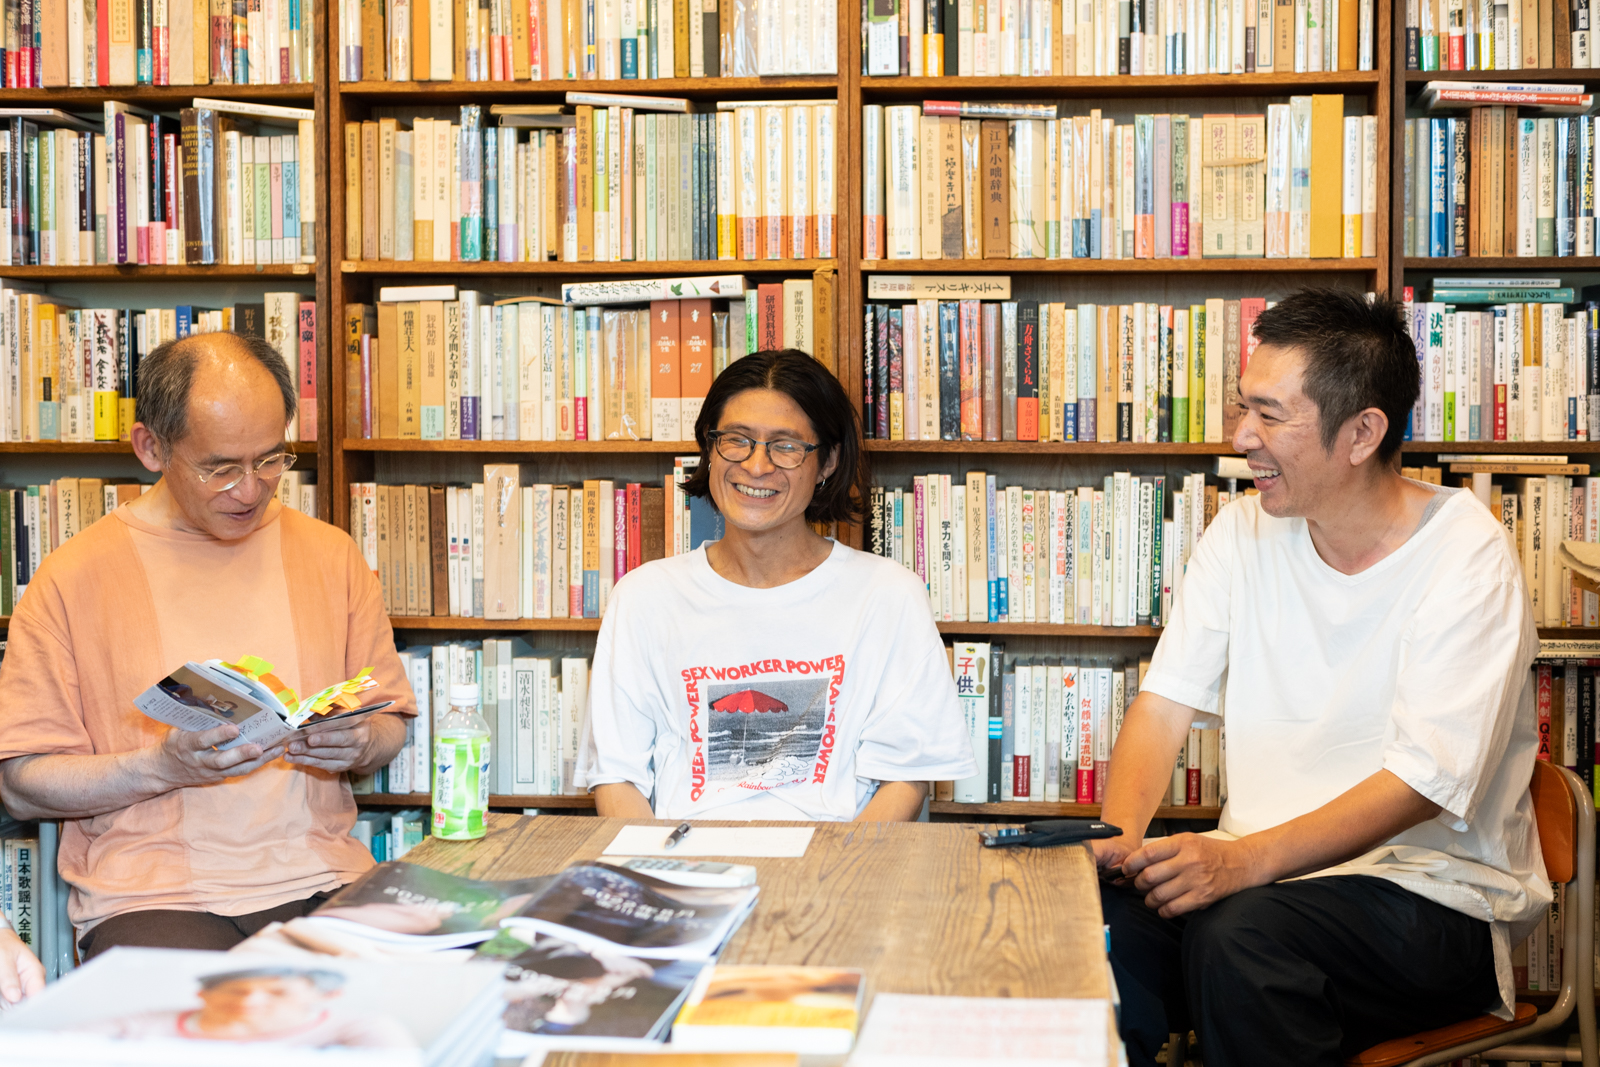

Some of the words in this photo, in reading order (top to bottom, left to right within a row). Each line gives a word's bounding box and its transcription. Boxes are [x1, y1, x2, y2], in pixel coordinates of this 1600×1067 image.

[989, 130, 1003, 203] 江戸小咄辞典
[1454, 120, 1466, 206] 殺される側の論理
[924, 281, 1005, 293] イエス・キリスト
[449, 306, 459, 389] 江戸文学問わず語り
[794, 290, 804, 351] 評論明治大正の歌
[1005, 308, 1016, 377] 安部公房全作品
[1123, 314, 1133, 356] わが大正
[1228, 305, 1237, 341] 安部公房
[1430, 312, 1444, 348] 決断
[1554, 307, 1563, 353] 国民の天皇
[1023, 323, 1034, 386] 方舟さくら丸
[1122, 362, 1133, 393] 秋山清
[1511, 309, 1520, 401] デモクラシーの理想と現実
[450, 400, 458, 432] 円地文子
[1003, 388, 1017, 397] 14
[1025, 401, 1034, 434] 安部公房
[1041, 377, 1049, 416] 安岡章太郎
[535, 489, 548, 575] マガジン青春譜
[587, 490, 596, 537] 開高健全作品
[615, 496, 625, 551] 生き方の定義
[630, 490, 639, 531] 死者の奢り
[870, 494, 884, 554] 山を考える
[973, 507, 982, 563] 児童文学の世界
[434, 518, 446, 573] 小説の世界
[942, 520, 951, 572] 学力を問う
[681, 666, 712, 682] SEX
[710, 659, 787, 681] WORKER
[785, 654, 844, 675] POWER
[685, 680, 703, 743] POWER
[1080, 698, 1092, 767] 似顔絵漂流記
[812, 725, 836, 784] POWER
[18, 848, 32, 945] 日本歌謡大全集
